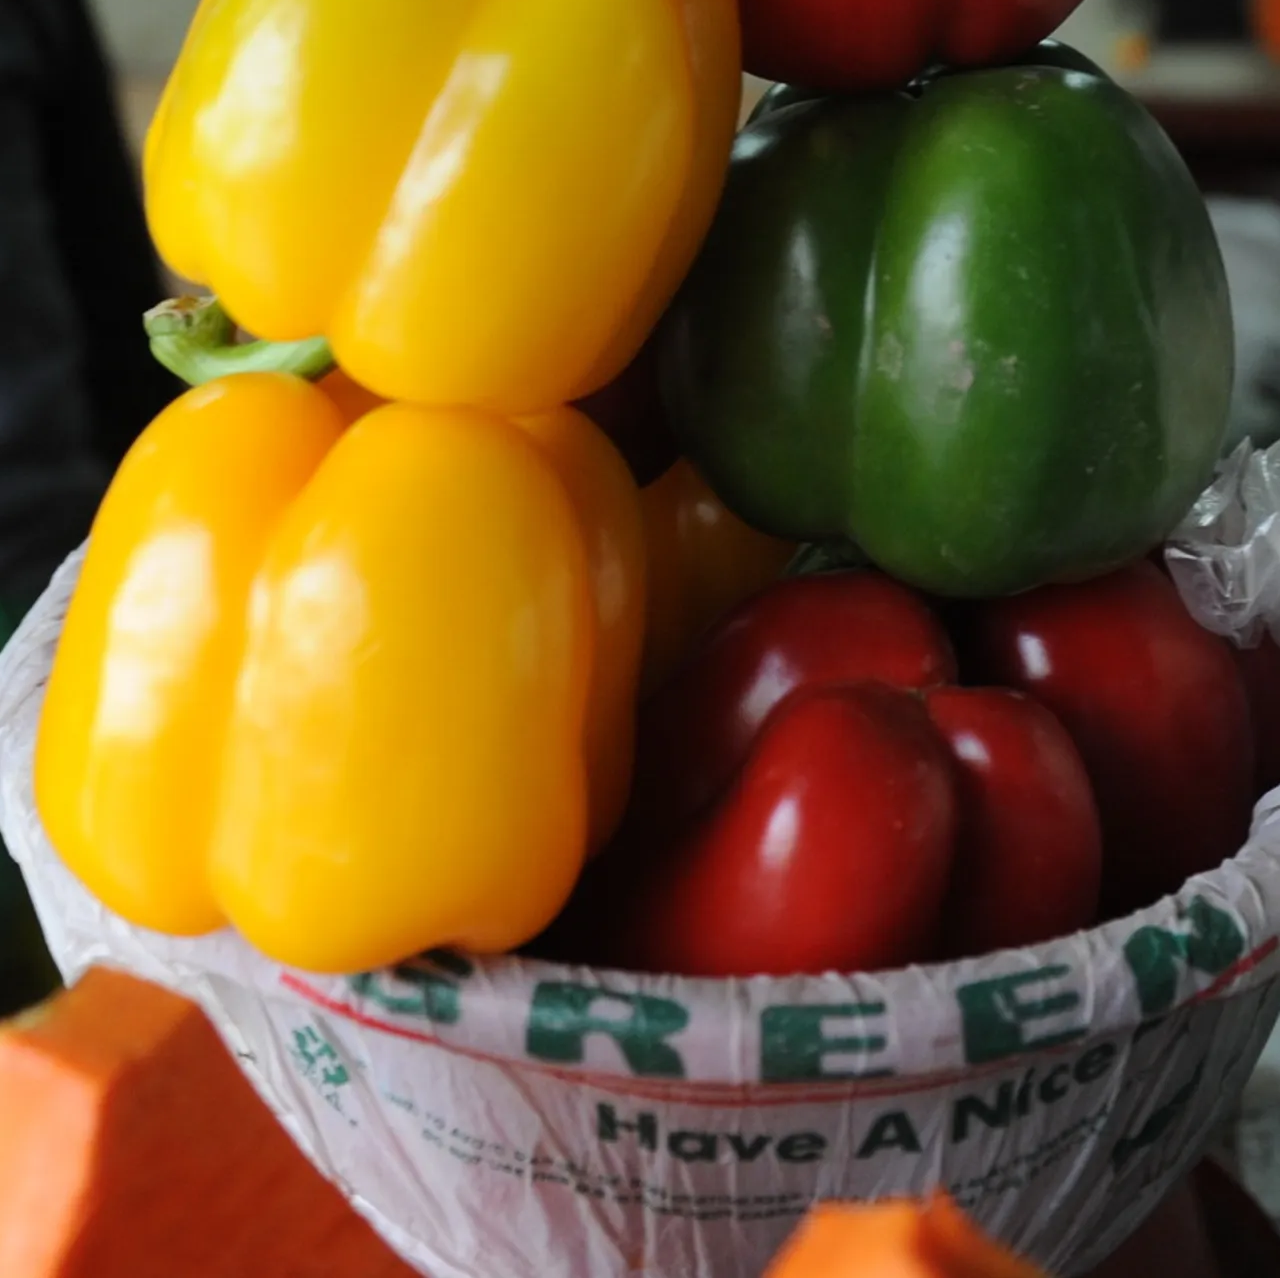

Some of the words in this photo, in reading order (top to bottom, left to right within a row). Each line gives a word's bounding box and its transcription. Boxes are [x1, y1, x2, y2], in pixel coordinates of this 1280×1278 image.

[348, 894, 1245, 1084] GREEN
[596, 1101, 827, 1164] Have
[855, 1109, 923, 1160] A
[948, 1041, 1118, 1146] Nice
